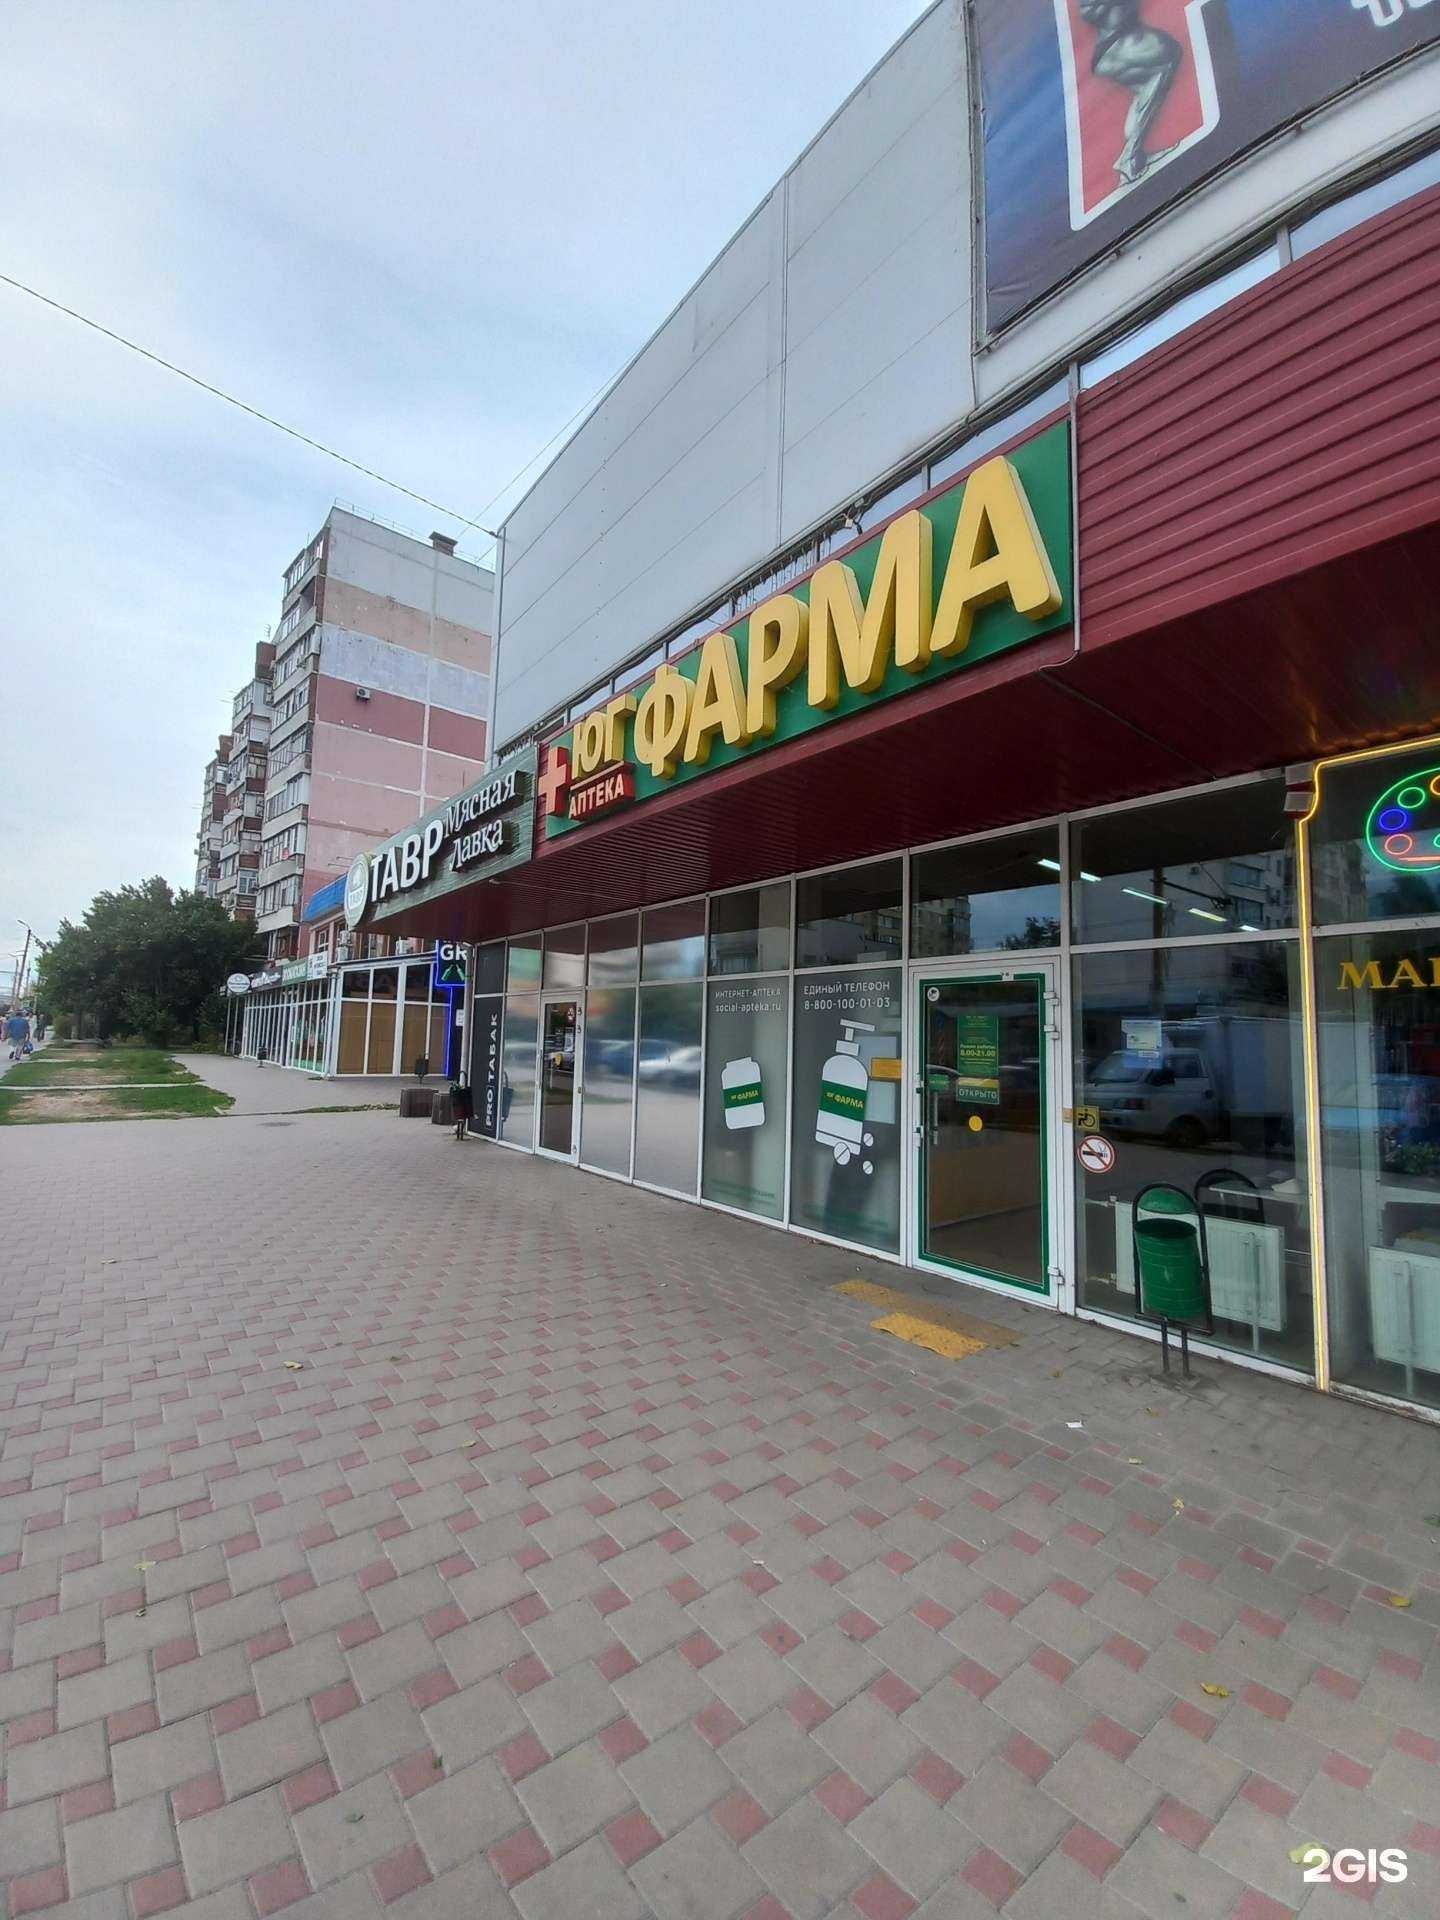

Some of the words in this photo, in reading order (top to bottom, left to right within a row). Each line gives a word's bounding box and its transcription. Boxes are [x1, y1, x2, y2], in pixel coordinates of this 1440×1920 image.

[572, 693, 637, 780] ЮГ
[634, 455, 1062, 779] ФАРМА
[568, 773, 625, 819] АПТЕКА
[444, 769, 517, 838] Мясная
[370, 818, 445, 902] ТАВР
[715, 988, 781, 999] ИНТЕРНЕТ-АПТЕКА
[804, 982, 842, 995] ЕДИНЫЙ
[844, 981, 890, 992] ТЕЛЕФОН
[715, 1003, 781, 1013] social-apteka.ru
[804, 997, 890, 1010] 8-800-100-01-03
[958, 1088, 998, 1099] ОТКРЫТО
[834, 1094, 864, 1109] ФАРМА
